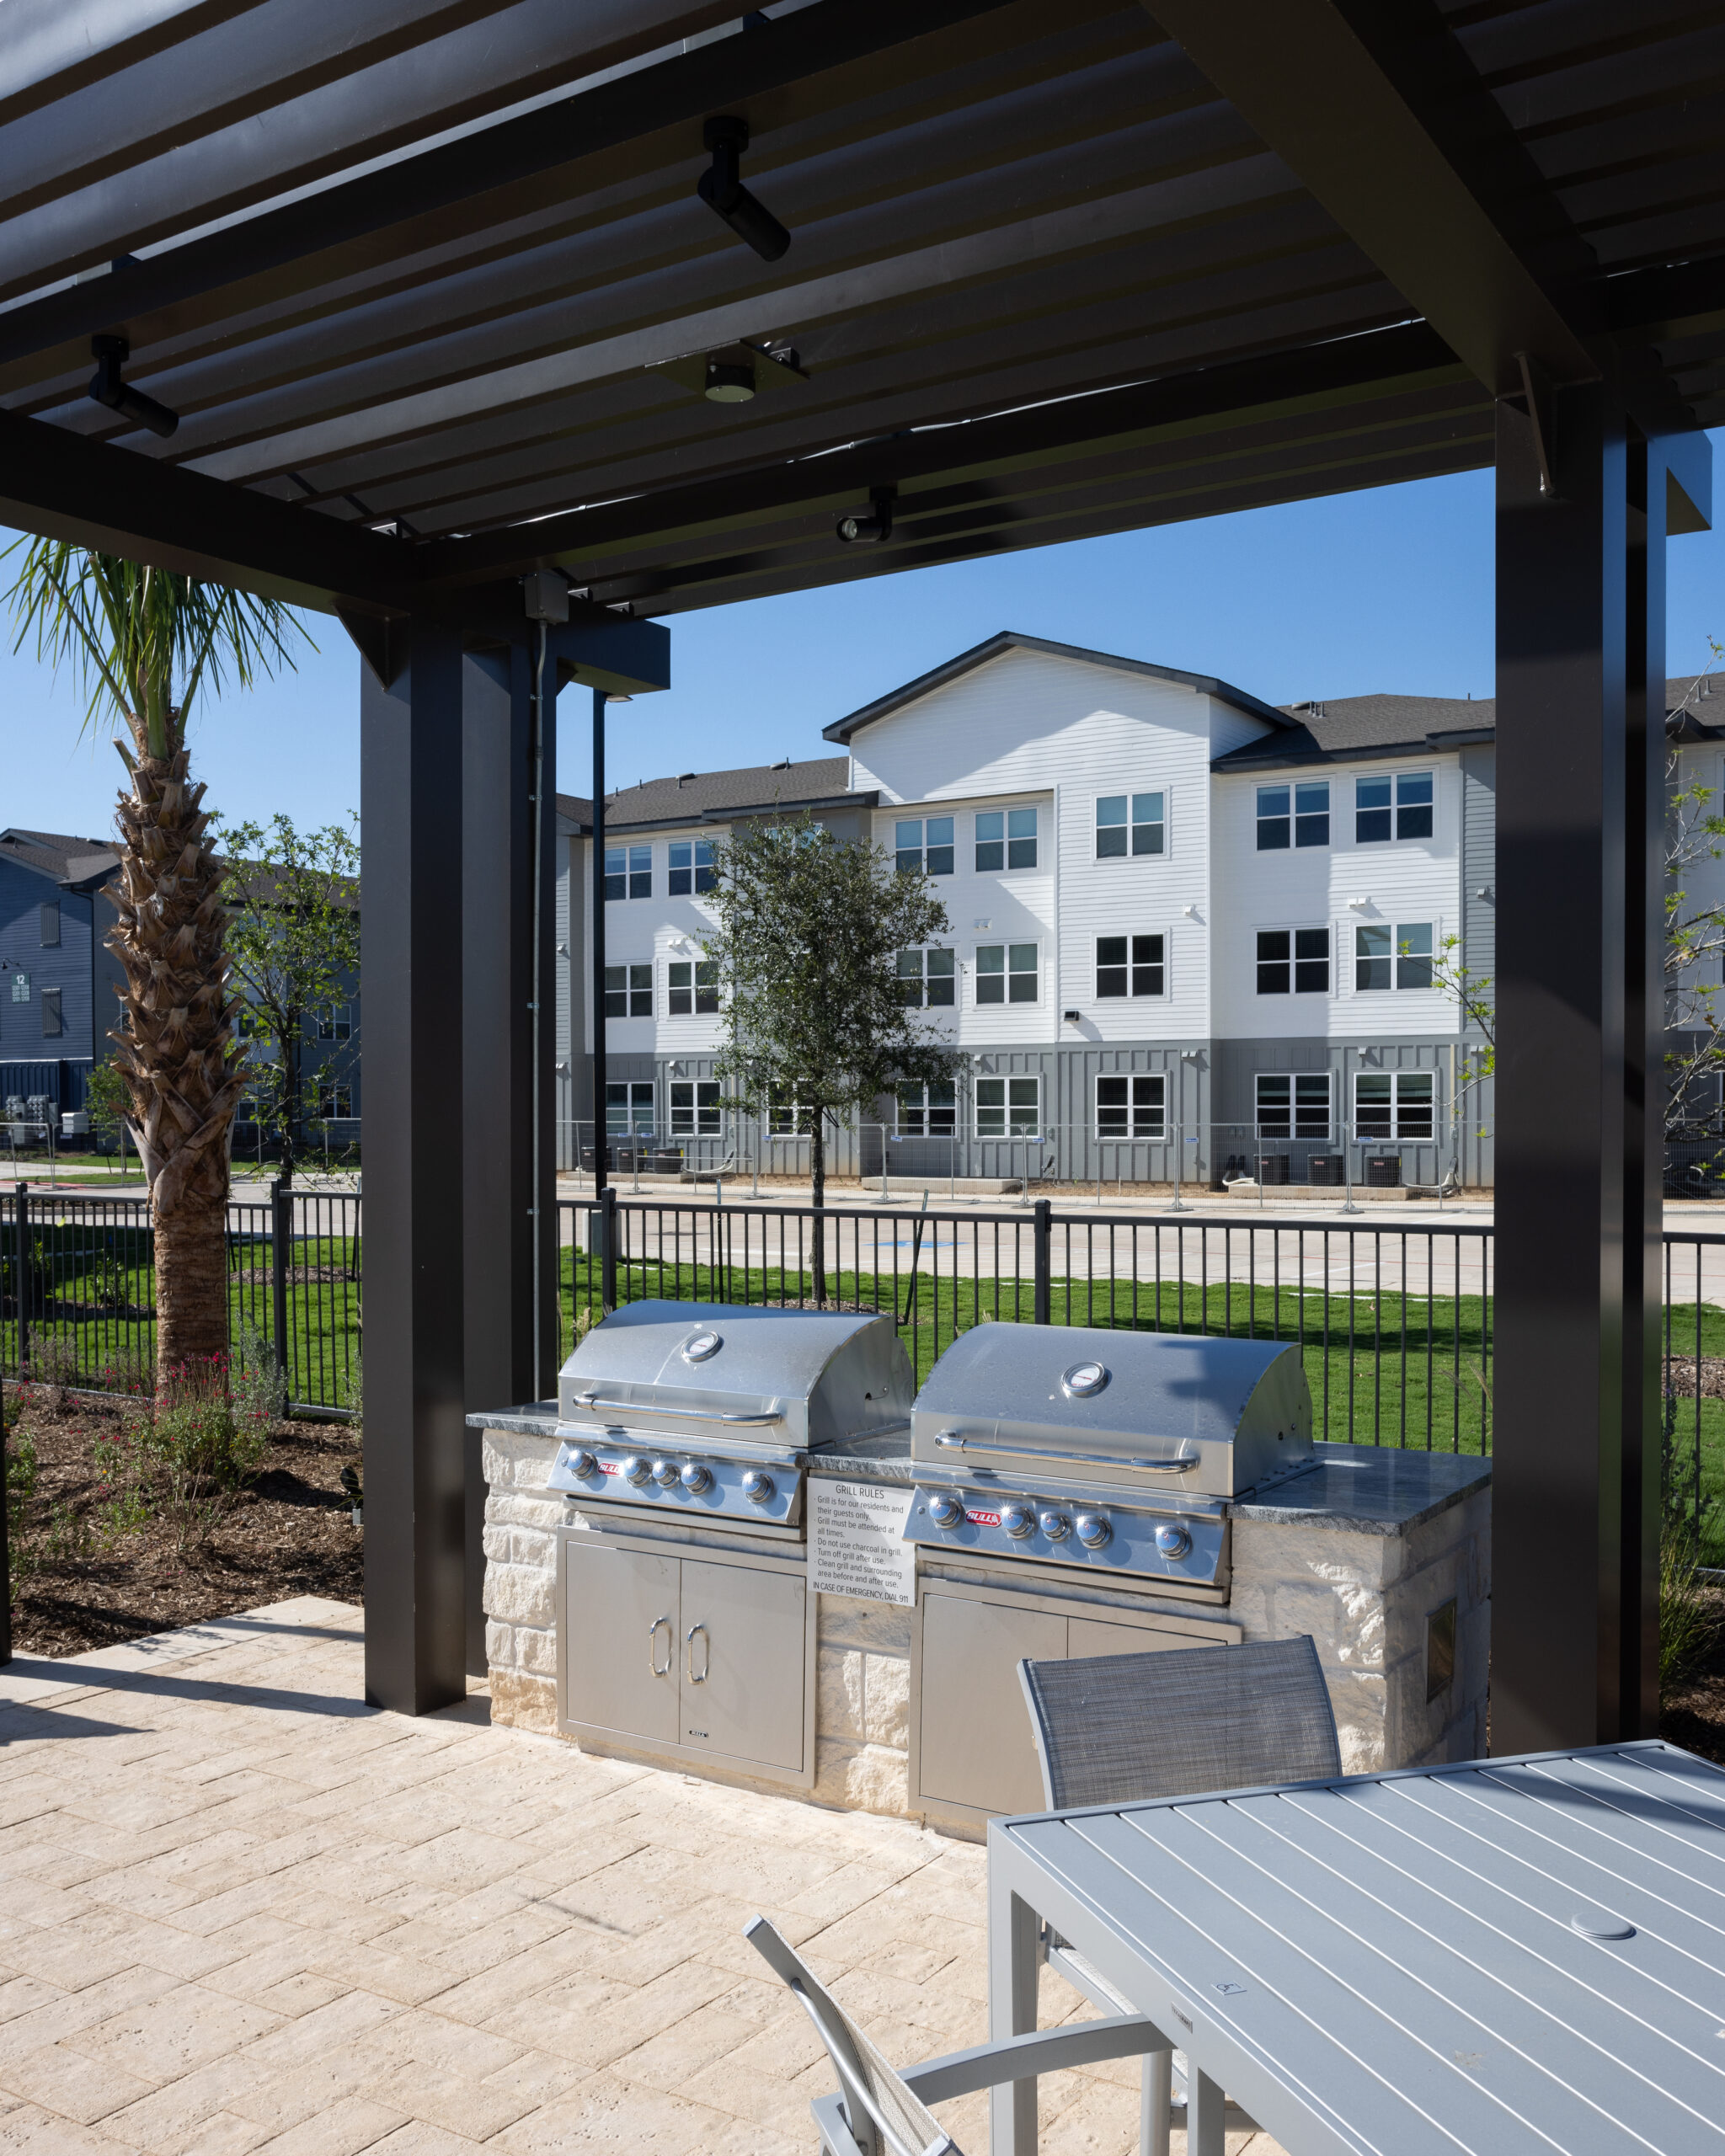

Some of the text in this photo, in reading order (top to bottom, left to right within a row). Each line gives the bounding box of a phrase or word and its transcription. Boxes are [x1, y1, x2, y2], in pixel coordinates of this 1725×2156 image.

[16, 974, 24, 985] 12
[836, 1485, 884, 1499] GRILL RULES
[861, 1502, 889, 1511] residents
[856, 1512, 870, 1520] only.
[967, 1513, 991, 1522] BULL
[826, 1529, 845, 1537] times.
[858, 1524, 886, 1532] attended
[818, 1548, 830, 1556] Turn
[856, 1554, 870, 1562] after
[853, 1543, 879, 1553] charcoal
[889, 1548, 902, 1556] grill.
[818, 1558, 835, 1567] Clean
[864, 1566, 902, 1579] surrounding
[833, 1572, 853, 1581] before
[869, 1577, 883, 1586] after
[820, 1582, 835, 1592] CASE
[846, 1587, 883, 1600] EMERGENCY,
[885, 1593, 898, 1601] DIAL
